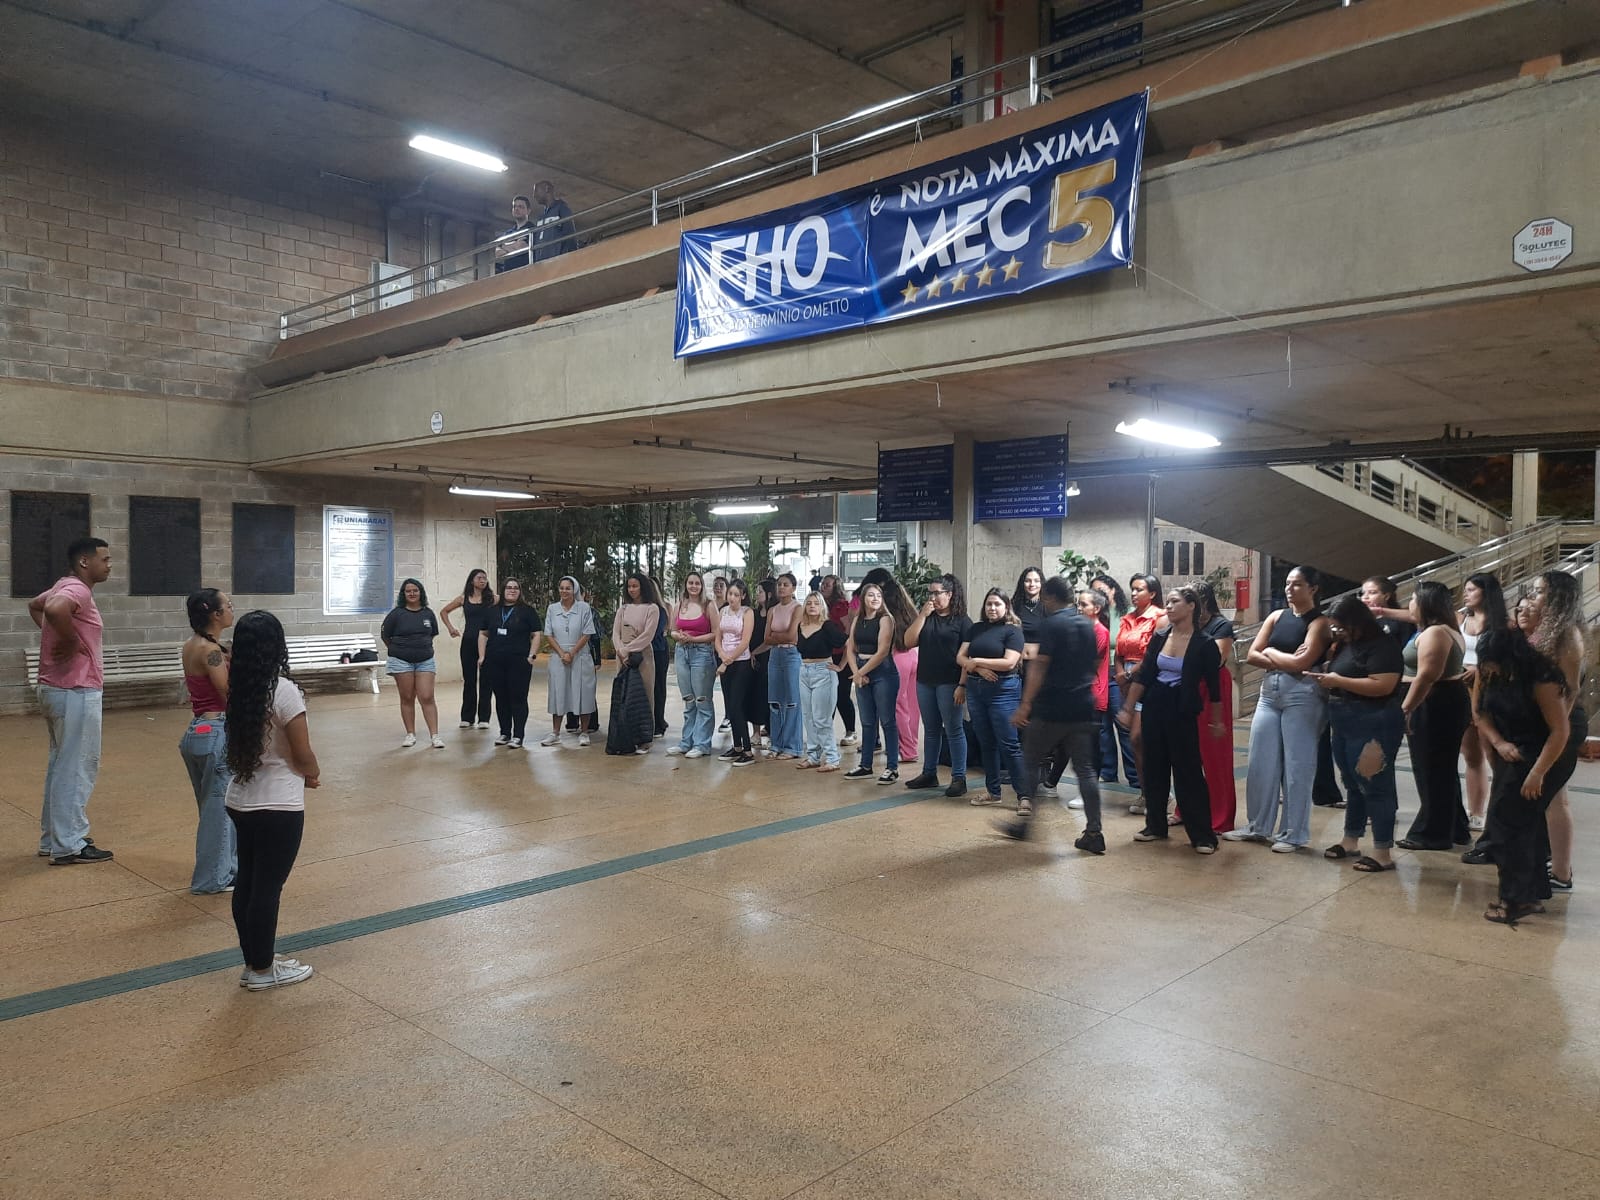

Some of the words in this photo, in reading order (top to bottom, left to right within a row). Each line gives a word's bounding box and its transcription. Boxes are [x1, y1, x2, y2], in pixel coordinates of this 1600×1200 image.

[870, 188, 887, 217] é
[899, 166, 979, 209] NOTA
[987, 118, 1121, 183] MÁXIMA
[897, 184, 1032, 277] MEC
[1042, 159, 1118, 270] 5
[1519, 239, 1567, 253] SOLUTEC
[1532, 226, 1553, 238] 24H
[710, 214, 833, 303] FHO
[746, 308, 800, 330] HERMÍNIO
[803, 297, 849, 319] OMETTO
